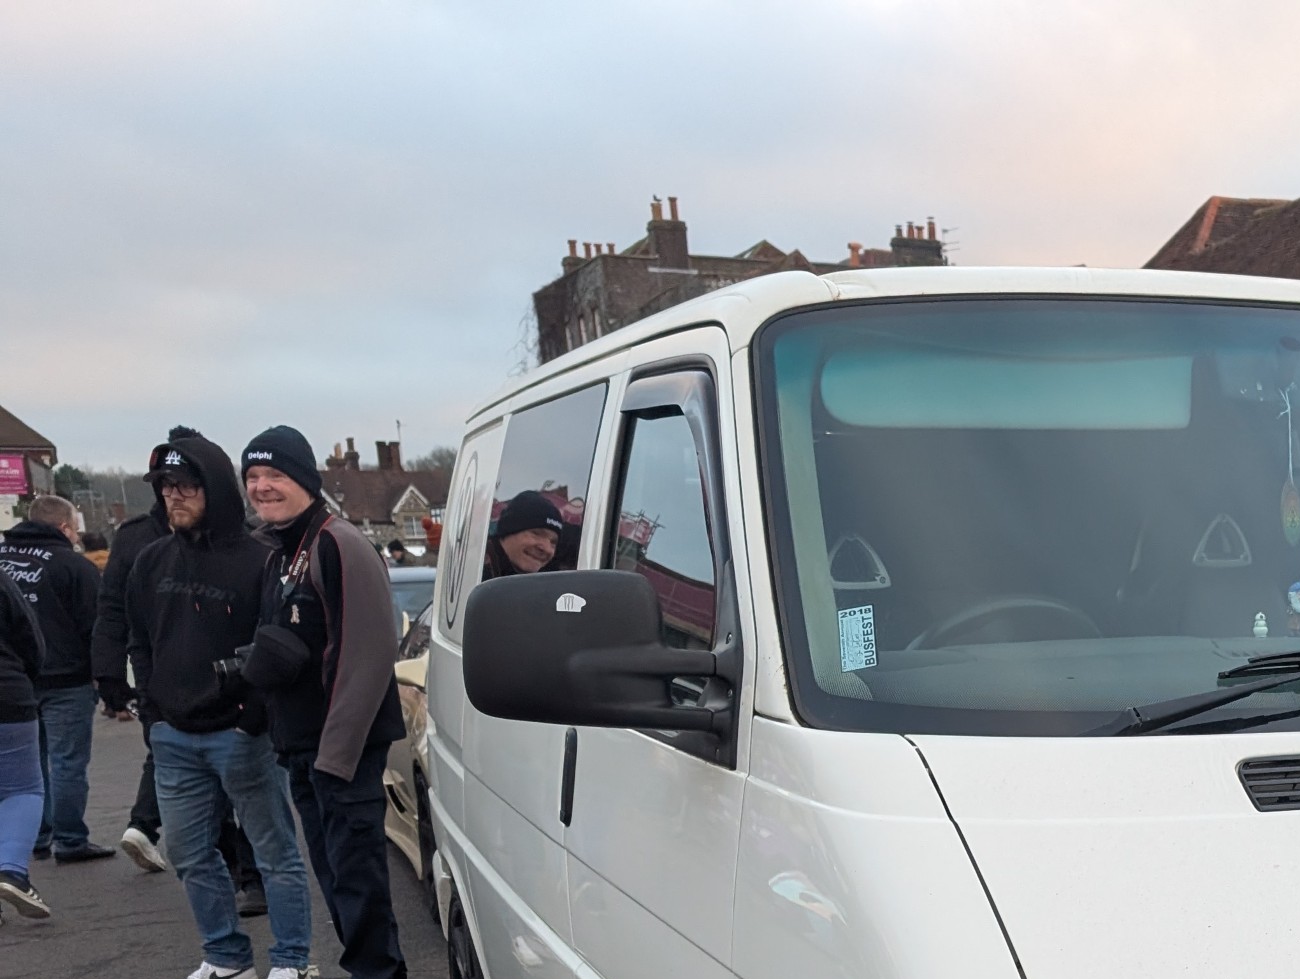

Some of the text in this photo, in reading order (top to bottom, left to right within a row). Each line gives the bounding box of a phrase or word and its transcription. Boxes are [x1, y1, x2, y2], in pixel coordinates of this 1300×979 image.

[165, 450, 181, 466] LA
[0, 546, 53, 560] ENUINE
[840, 608, 872, 618] 2018
[862, 616, 875, 666] BUSFEST
